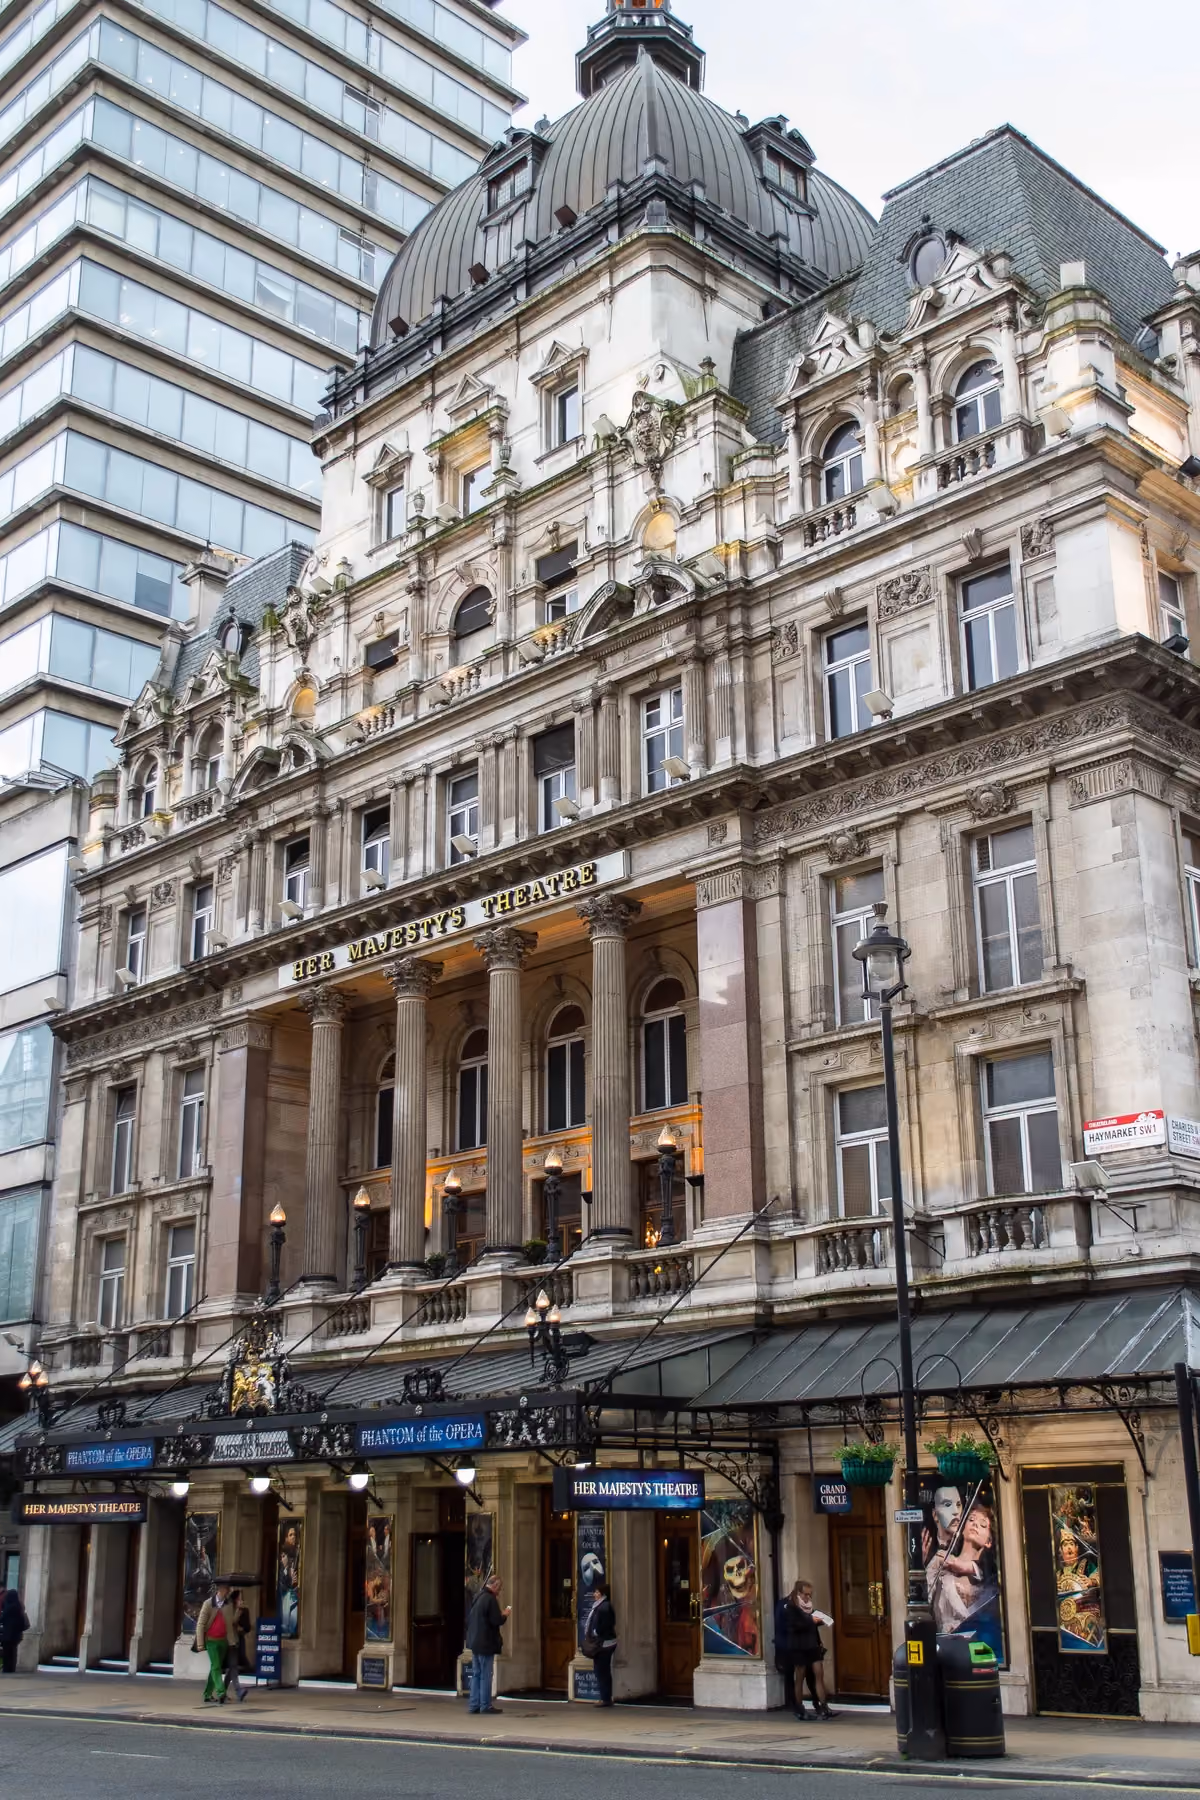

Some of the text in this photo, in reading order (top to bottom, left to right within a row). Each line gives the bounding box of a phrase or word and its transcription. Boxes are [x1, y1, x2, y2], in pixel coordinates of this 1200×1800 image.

[293, 863, 597, 980] HER MAJESTY'S THEATRE
[1089, 1124, 1157, 1143] HAYMARKET SW1
[1171, 1119, 1194, 1134] CHARLES
[1172, 1131, 1191, 1144] STREET
[361, 1422, 483, 1447] PHANTOM of the OPERA
[68, 1446, 152, 1465] PHANTOM of the OPERA
[573, 1481, 699, 1496] HER MAJESTY'S THEATRE
[820, 1484, 846, 1494] GRAND
[821, 1495, 847, 1505] CIRCLE
[25, 1502, 141, 1515] HER MAJESTY'S THEATRE
